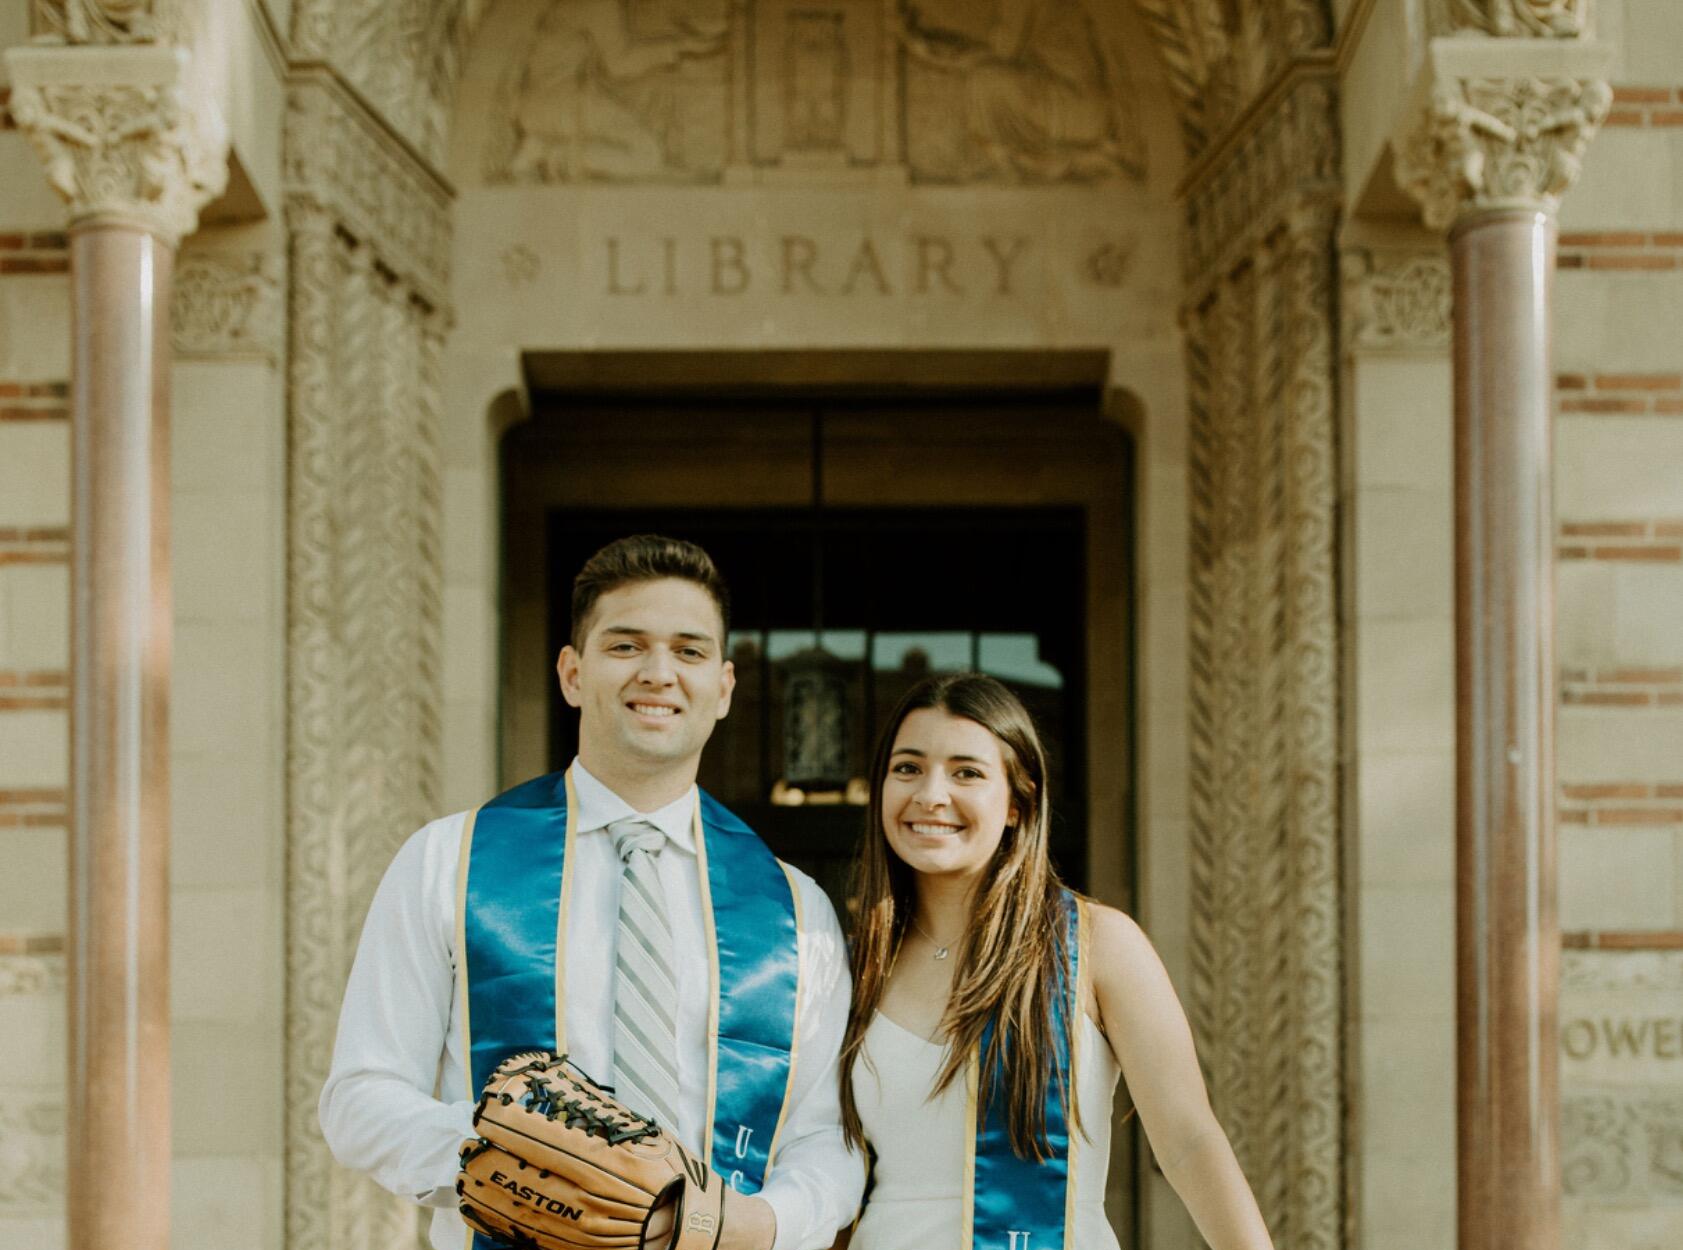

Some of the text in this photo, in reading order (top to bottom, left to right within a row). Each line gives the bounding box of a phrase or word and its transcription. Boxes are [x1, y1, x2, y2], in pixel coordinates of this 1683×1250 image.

[605, 233, 1032, 297] LIBRARY
[1561, 1016, 1683, 1061] OWE
[489, 1170, 584, 1221] EASTON
